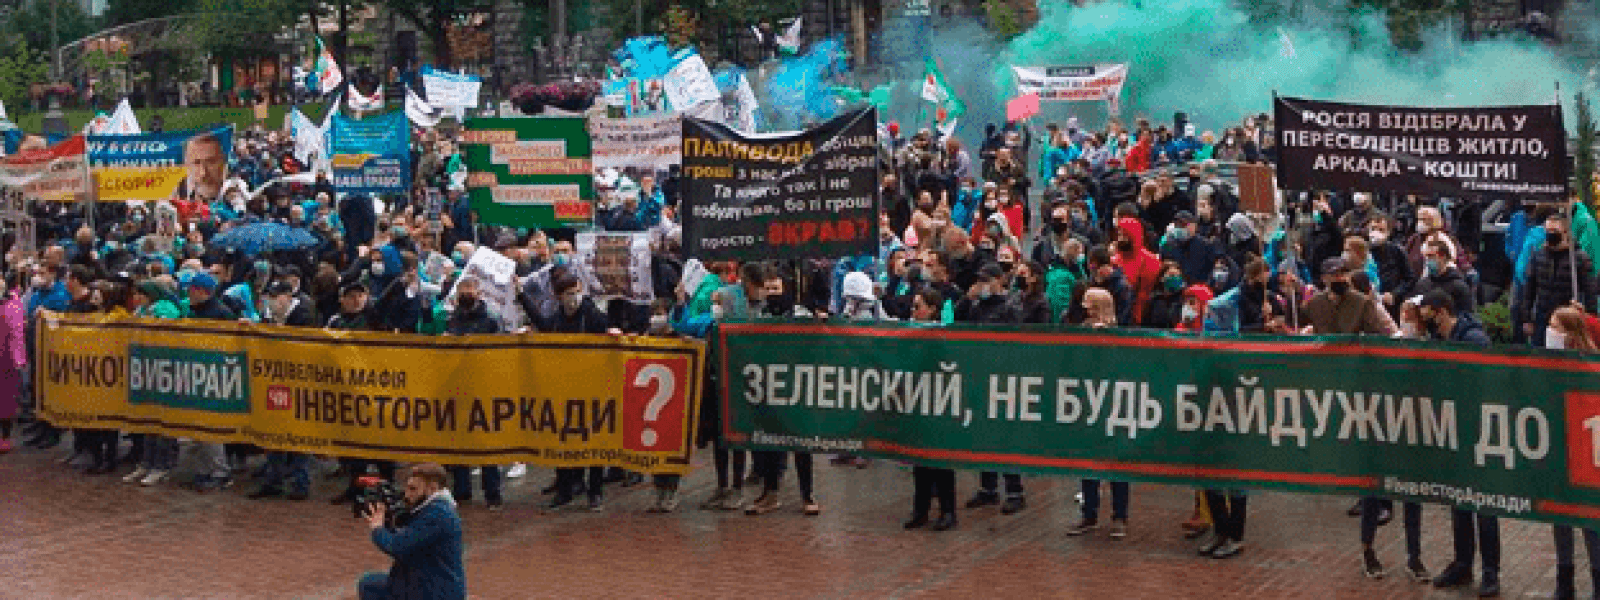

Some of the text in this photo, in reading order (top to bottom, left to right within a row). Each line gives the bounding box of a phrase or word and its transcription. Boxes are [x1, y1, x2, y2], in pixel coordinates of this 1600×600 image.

[1301, 110, 1528, 132] РОСІЯ ВІДІБРАЛА У
[684, 137, 814, 162] ПАЛИВОДА
[1282, 130, 1549, 158] ПЕРЕСЕЛЕНЦІВ ЖИТЛО,
[1313, 154, 1401, 177] АРКАДА
[1423, 161, 1519, 180] КОШТИ!
[130, 355, 244, 401] ВИБИРАЙ
[252, 358, 407, 390] БУДІВЕЛЬНА МАФІЯ
[294, 386, 457, 433] ІНВЕСТОРИ
[467, 397, 617, 443] АРКАДИ
[633, 363, 676, 447] ?
[742, 361, 973, 428] ЗЕЛЕНСКИЙ,
[987, 374, 1044, 422] НЕ
[1055, 378, 1162, 439] БУДЬ
[1176, 375, 1460, 451] БАЙДУЖИМ
[1473, 403, 1550, 471] ДО
